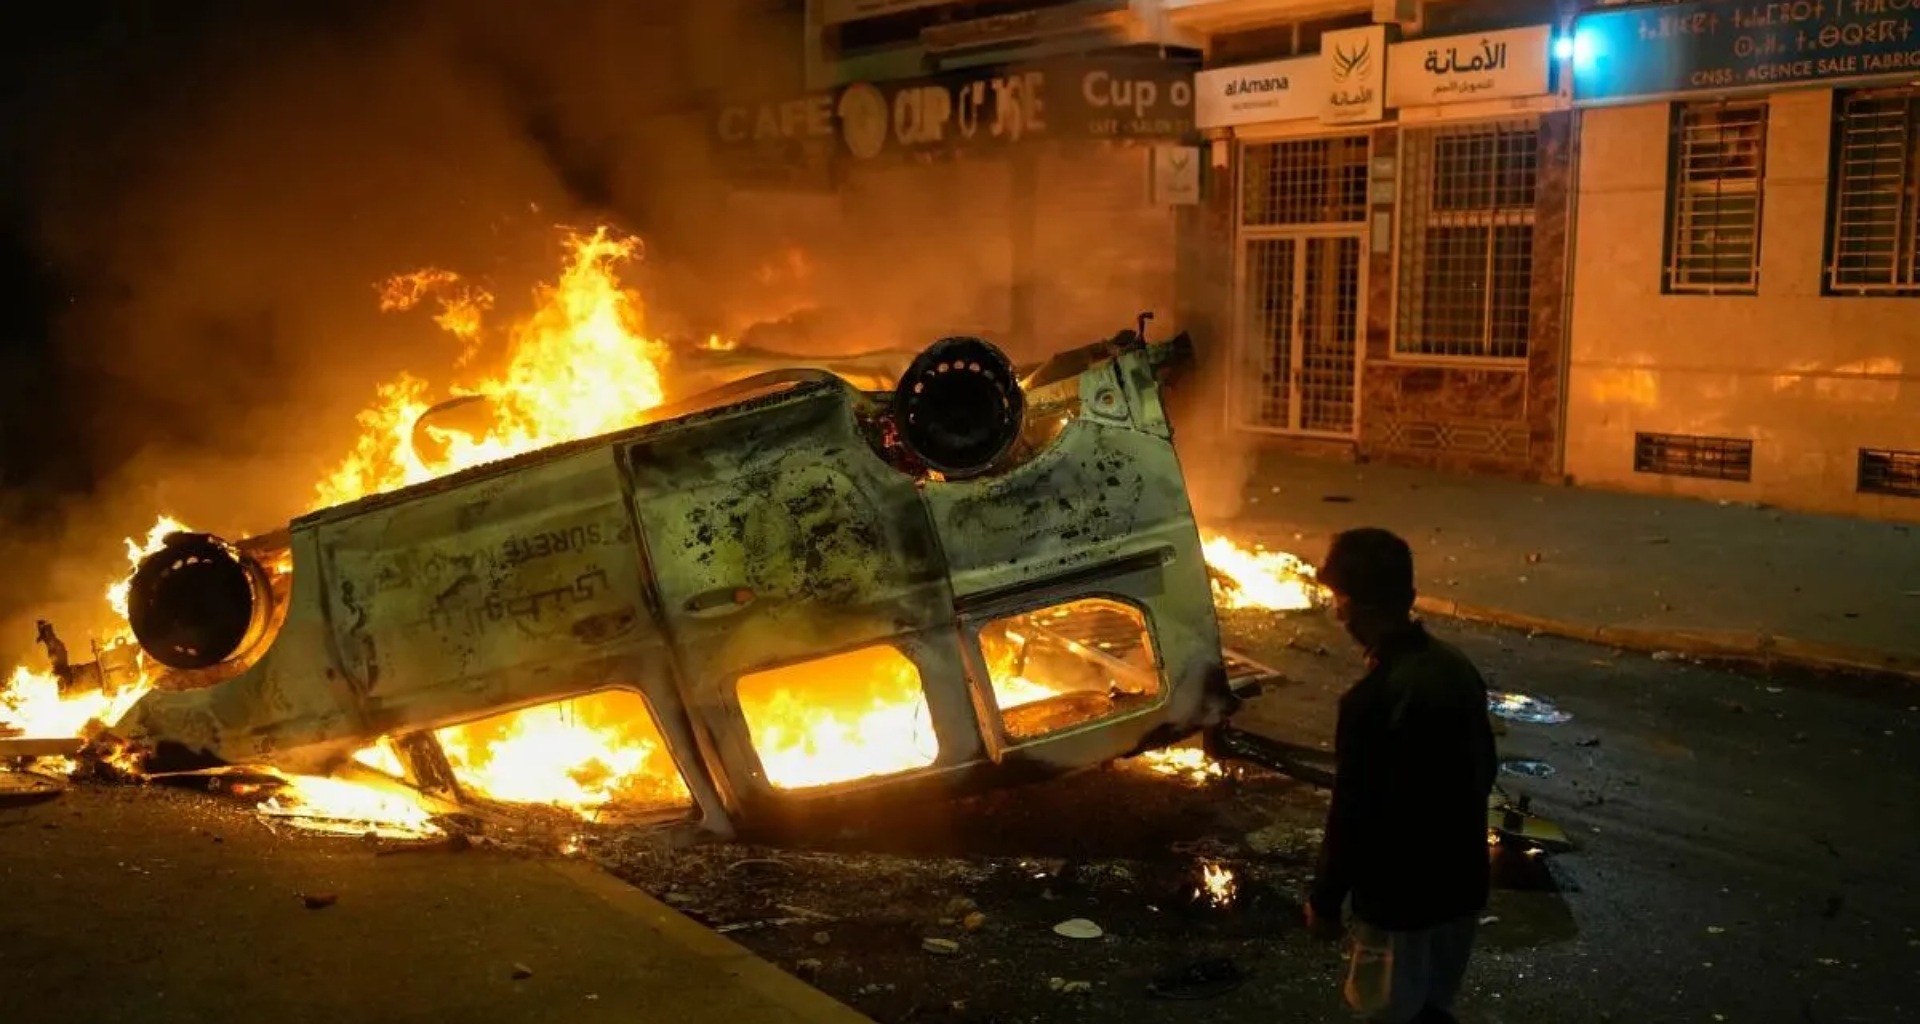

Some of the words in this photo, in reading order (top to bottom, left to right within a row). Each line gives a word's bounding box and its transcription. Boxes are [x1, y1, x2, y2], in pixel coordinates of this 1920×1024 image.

[1424, 36, 1507, 74] الأمانة
[1691, 67, 1733, 85] CNSS
[1745, 60, 1812, 81] AGENCE
[1817, 54, 1857, 73] SALE
[1082, 71, 1157, 117] Cup
[1170, 80, 1192, 107] o
[1225, 80, 1237, 96] al
[1239, 76, 1289, 94] Amana
